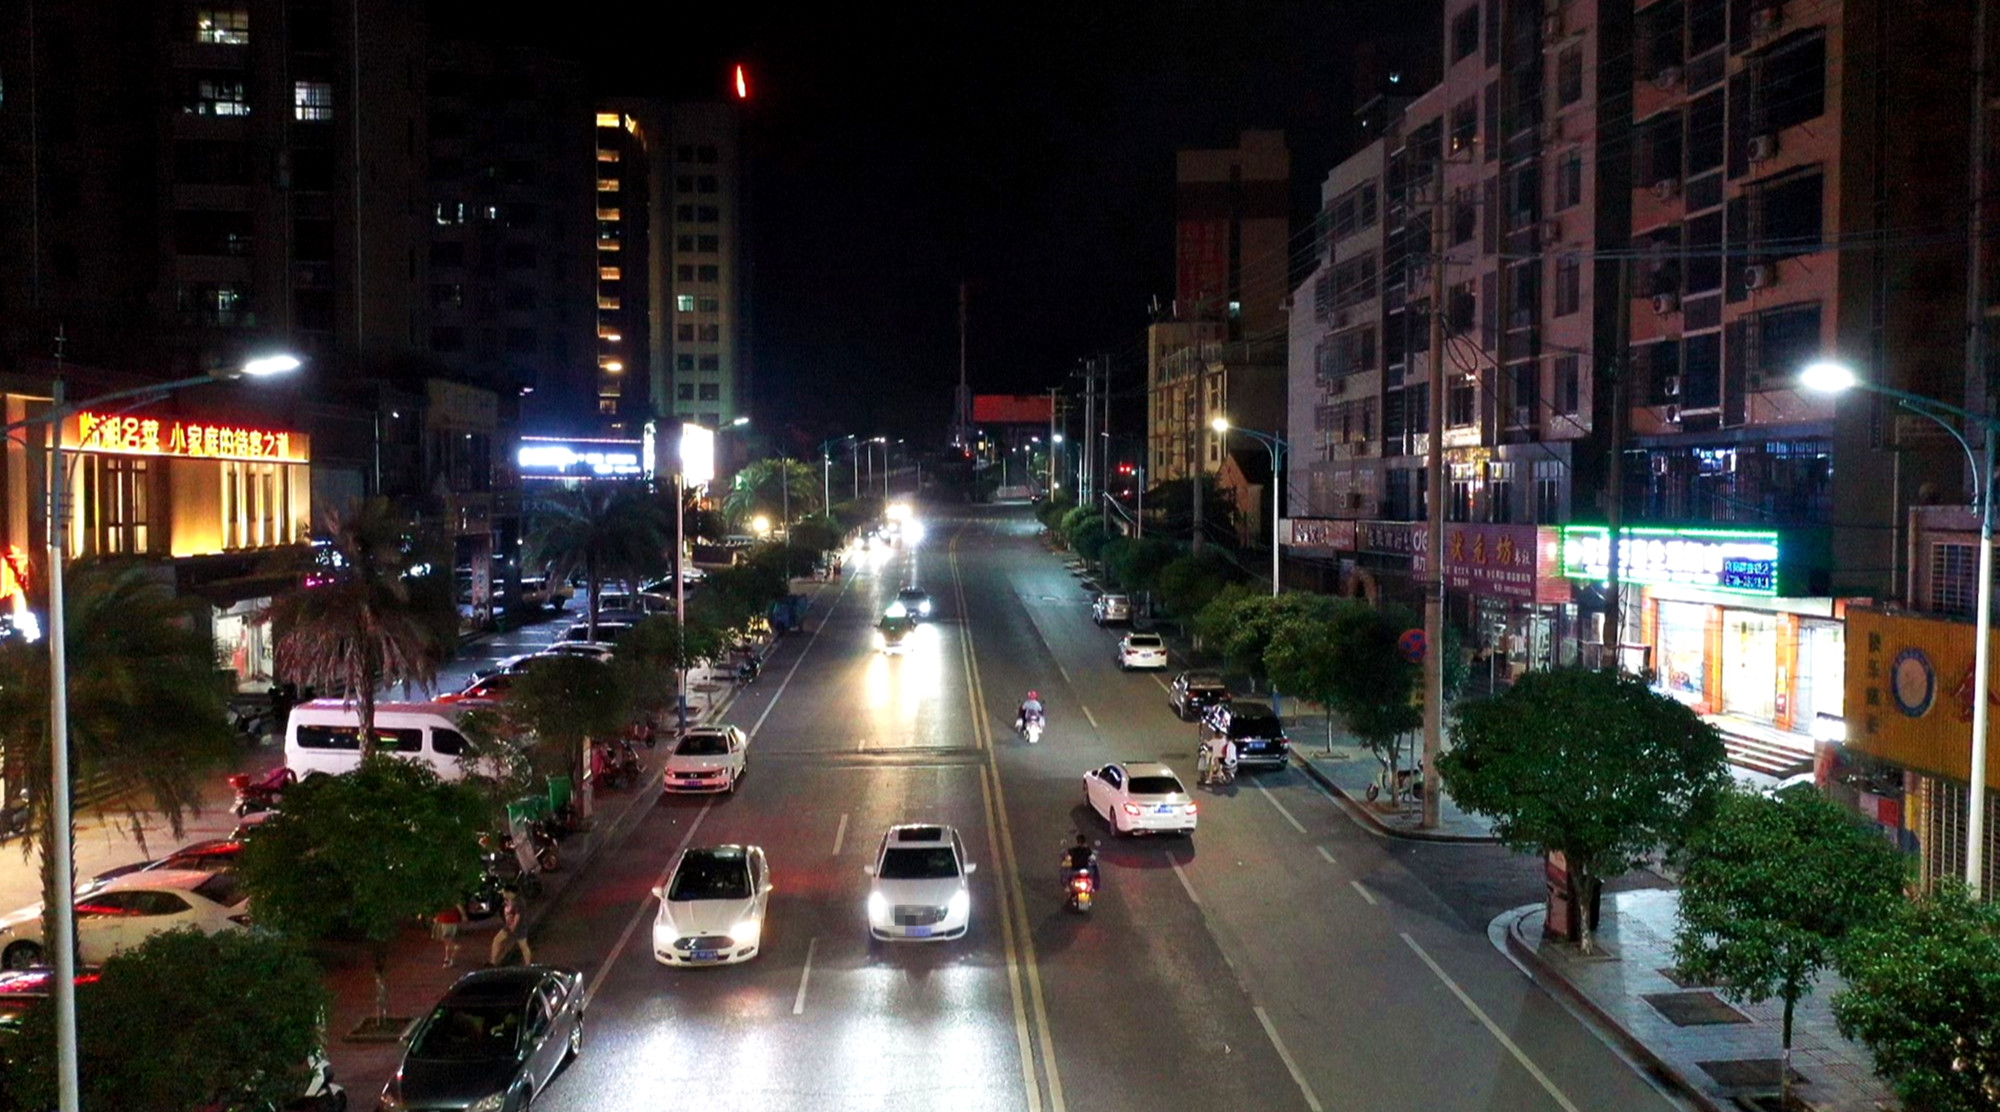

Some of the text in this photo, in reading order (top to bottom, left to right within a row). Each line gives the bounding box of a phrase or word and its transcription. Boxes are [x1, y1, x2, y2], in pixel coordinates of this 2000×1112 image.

[79, 412, 289, 459] 临湘名菜 小家庭的待客之道
